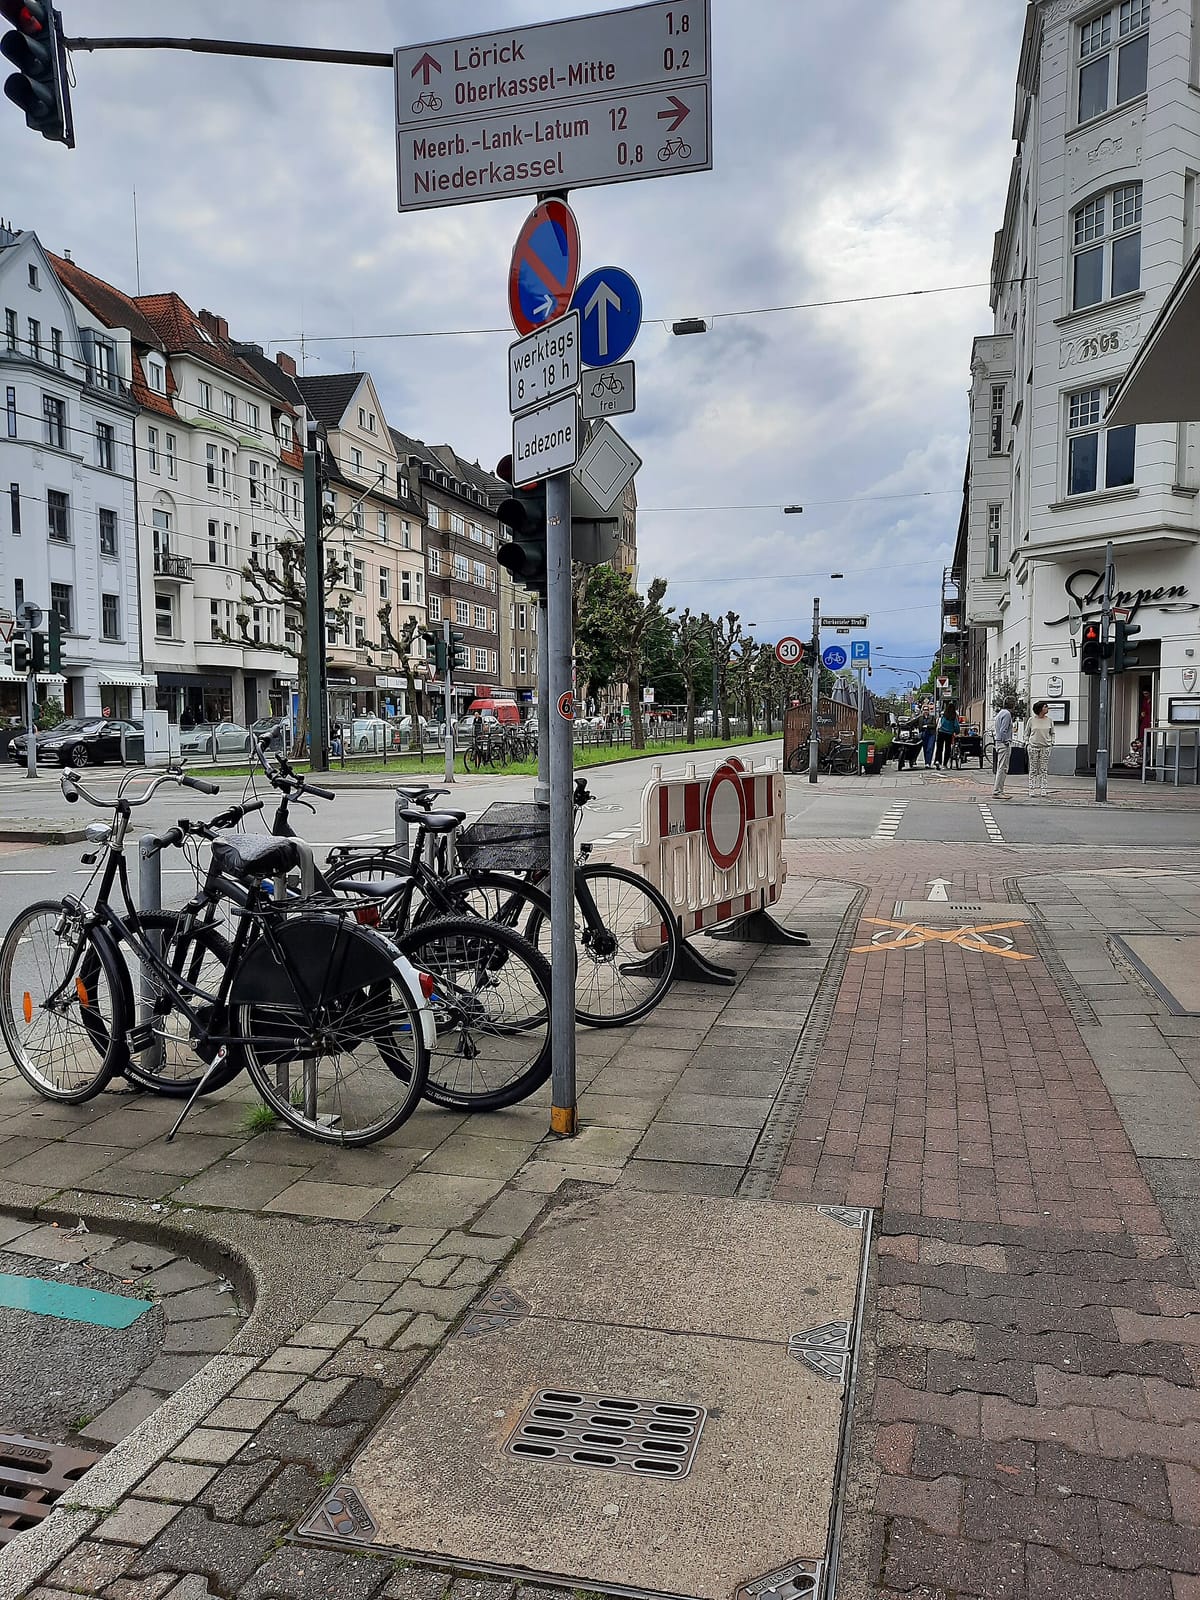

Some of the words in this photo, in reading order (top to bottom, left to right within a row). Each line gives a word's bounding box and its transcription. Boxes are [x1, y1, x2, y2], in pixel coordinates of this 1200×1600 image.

[454, 40, 526, 71] Lörick
[665, 12, 690, 35] 1,8
[454, 61, 616, 105] Oberkassel-Mitte
[663, 48, 690, 71] 0,2
[412, 117, 589, 161] Meerb.-Lank-Latum
[608, 107, 628, 131] 12
[413, 152, 564, 194] Niederkassel
[617, 142, 643, 166] 0,8
[514, 330, 574, 372] werktags
[517, 378, 525, 399] 8
[542, 364, 555, 387] 18
[562, 360, 570, 380] h
[599, 399, 616, 411] frei
[517, 426, 573, 461] Ladezone
[781, 644, 798, 657] 30
